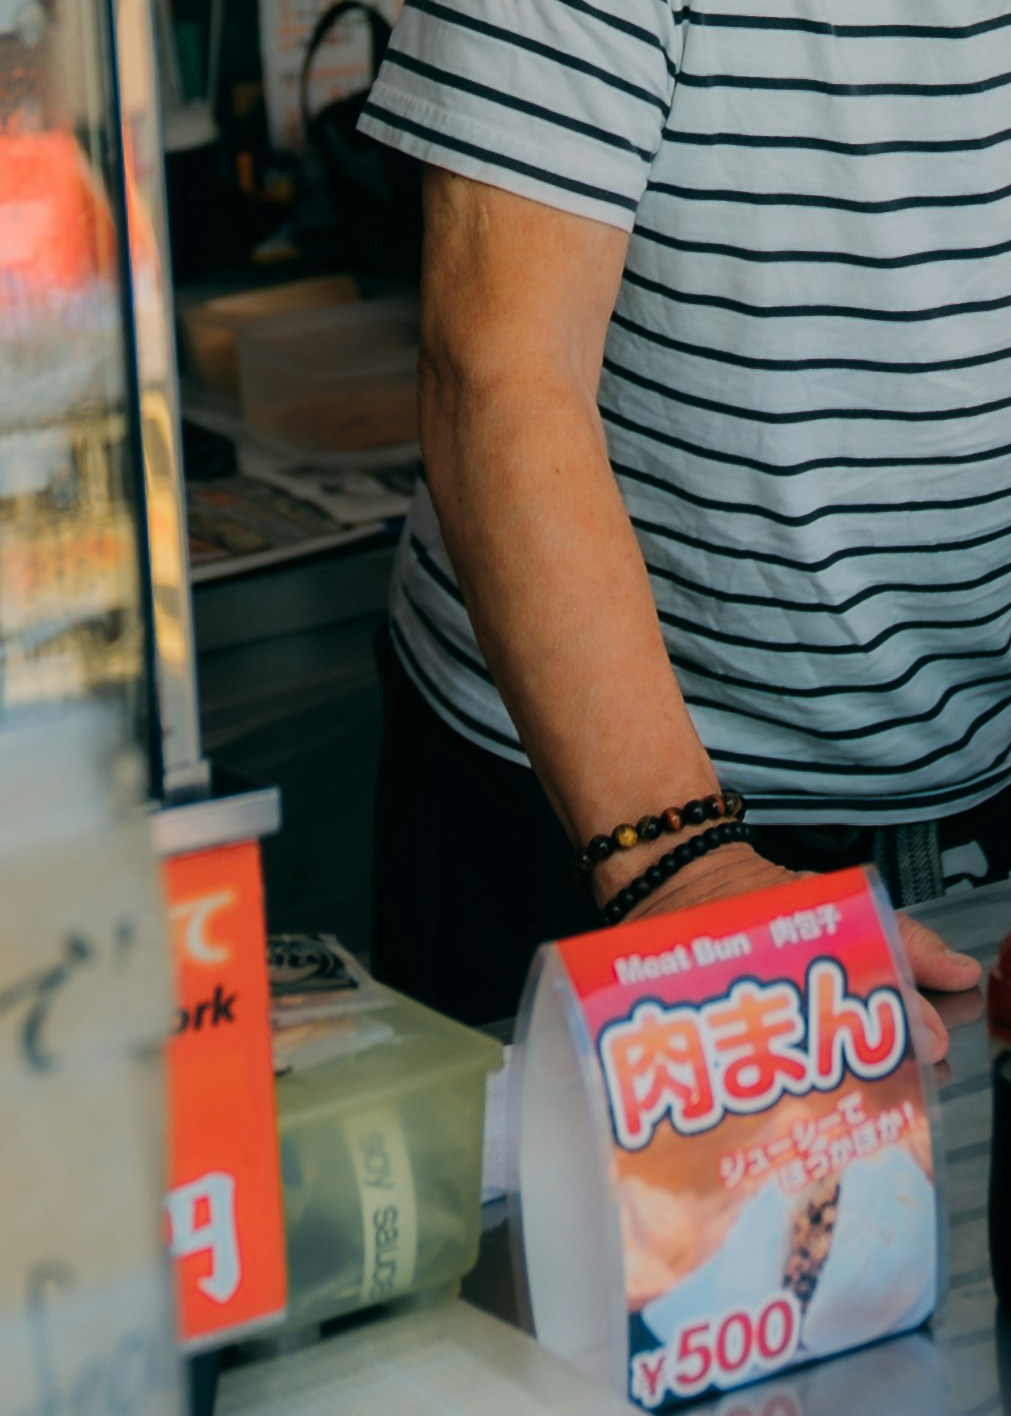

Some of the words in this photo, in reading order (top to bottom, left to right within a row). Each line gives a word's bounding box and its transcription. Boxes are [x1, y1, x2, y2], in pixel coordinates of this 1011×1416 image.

[612, 944, 692, 987] Meat
[692, 930, 752, 968] Bun
[768, 902, 844, 950] 肉包子
[600, 957, 904, 1151] 肉まん
[719, 1089, 867, 1186] ジューシーで
